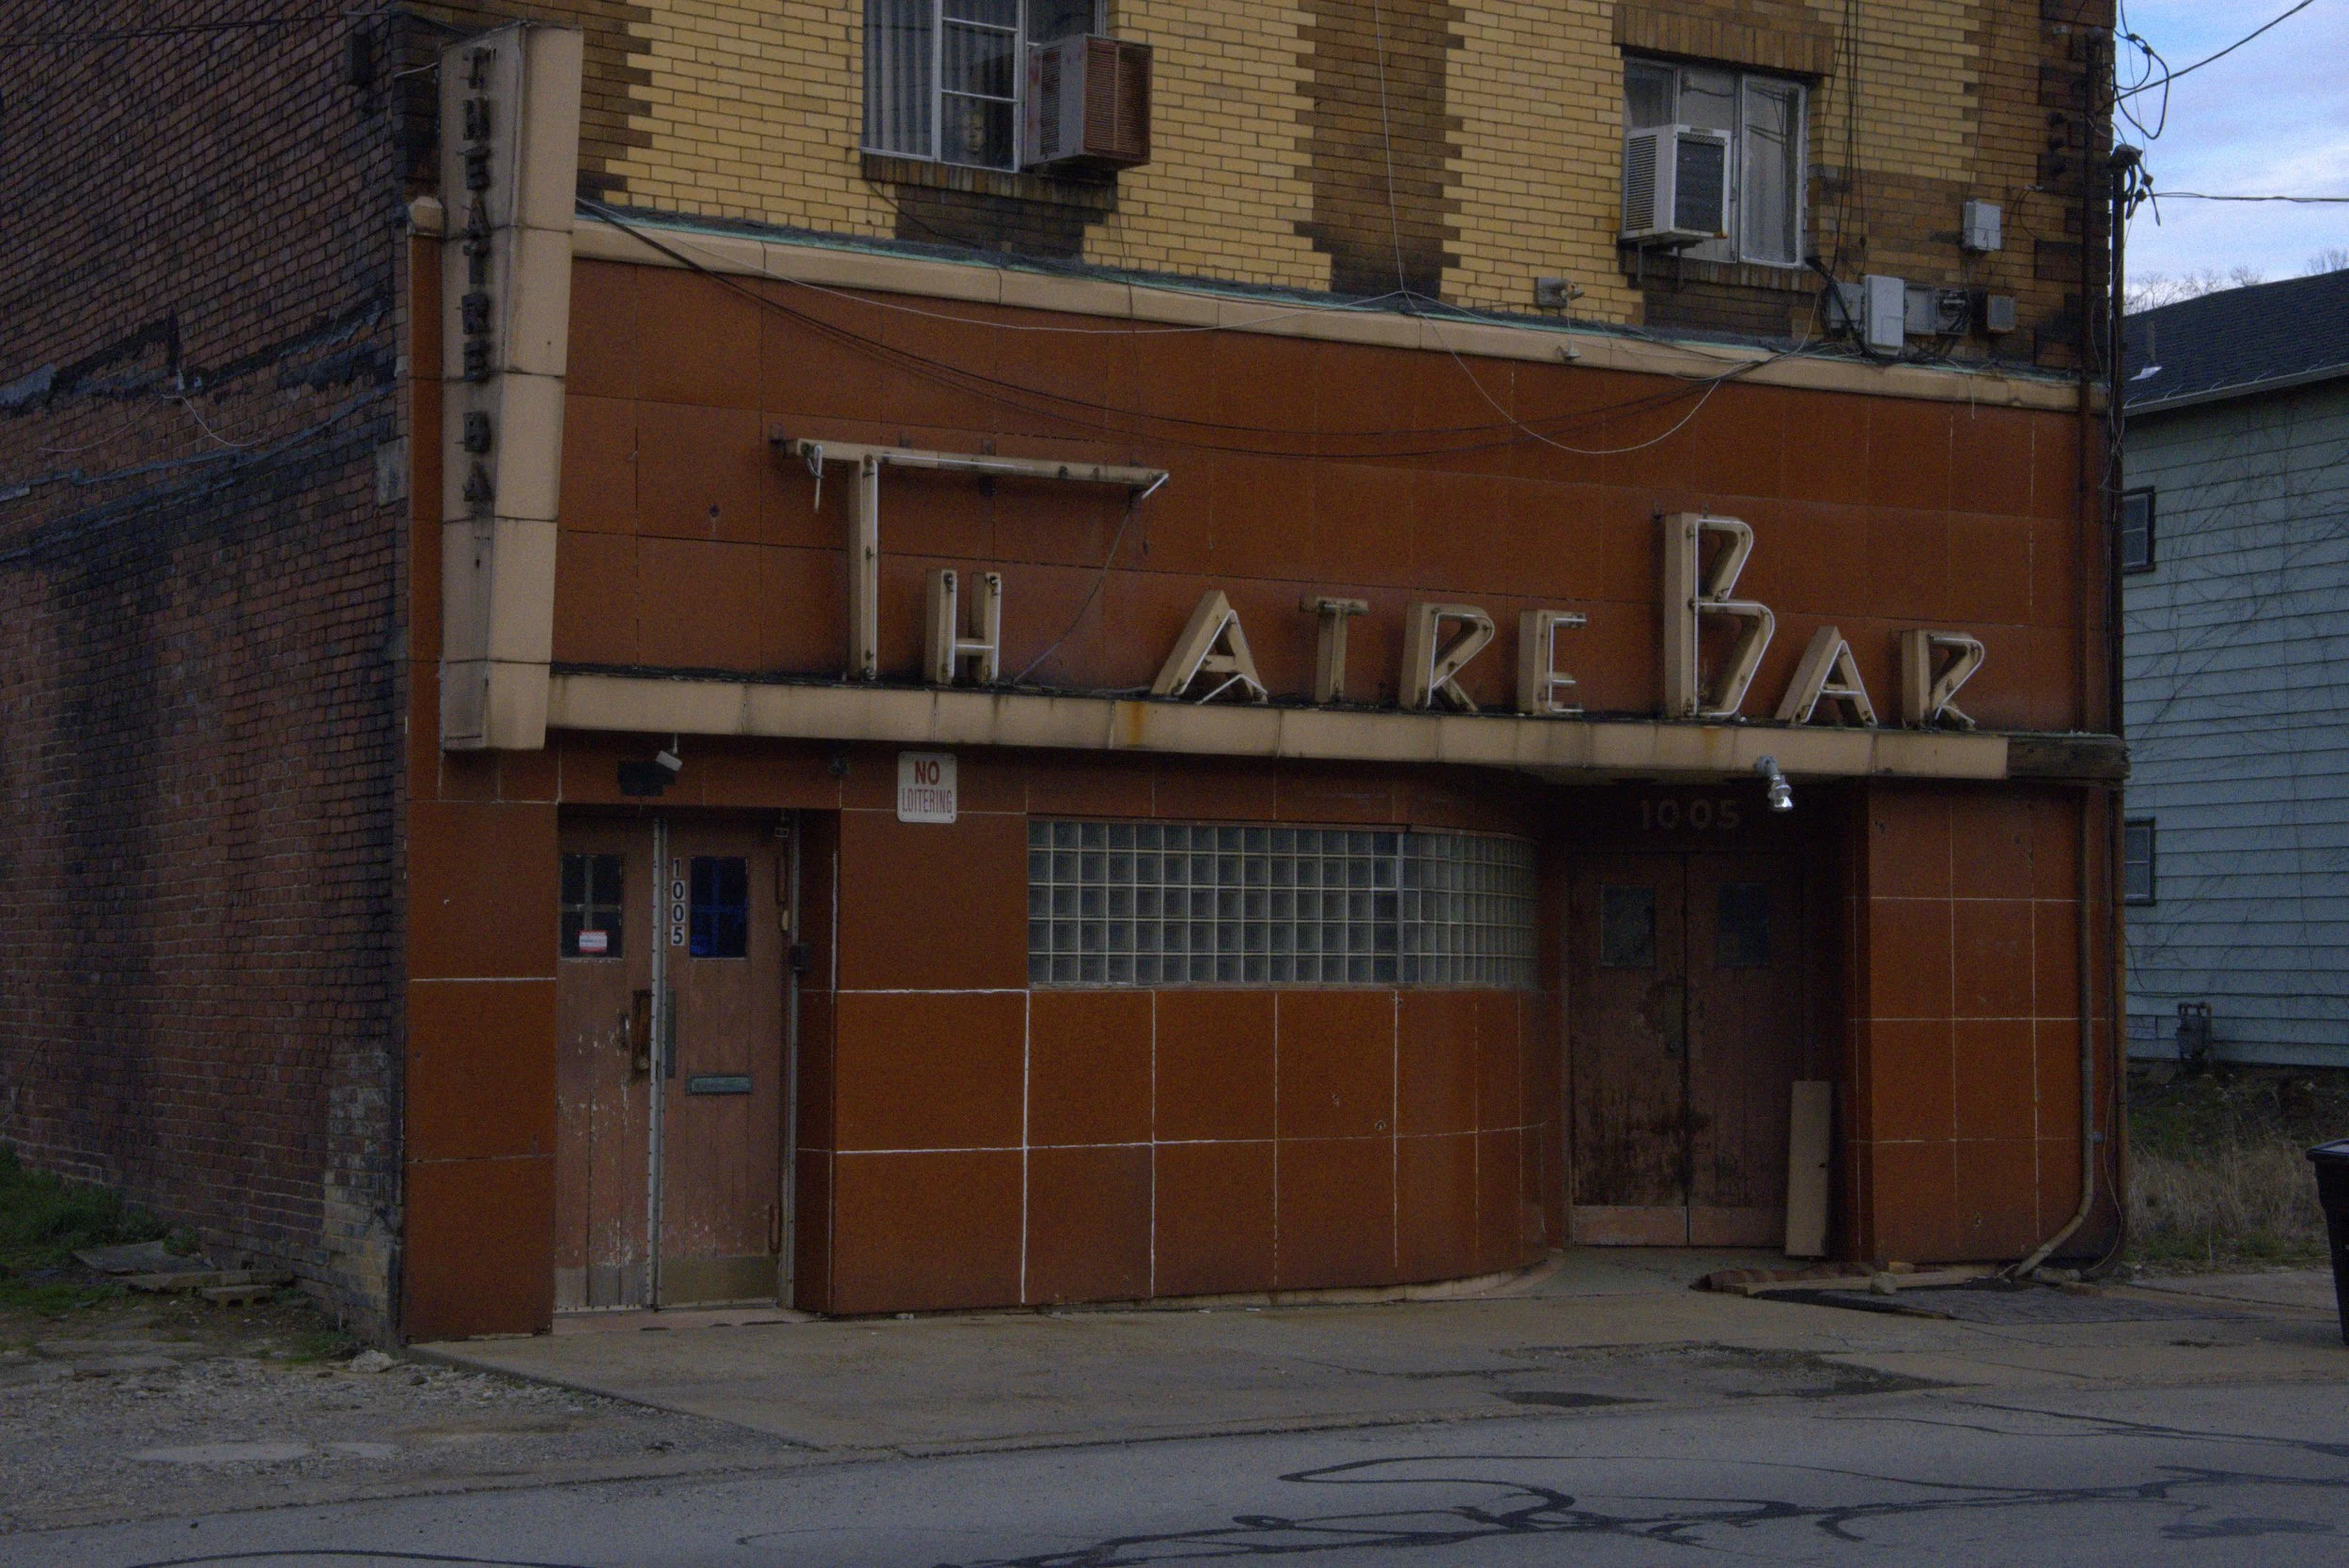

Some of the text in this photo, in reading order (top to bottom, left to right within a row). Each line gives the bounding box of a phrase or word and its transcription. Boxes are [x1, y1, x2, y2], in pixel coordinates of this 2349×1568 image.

[1663, 512, 1985, 731] BAR
[914, 760, 941, 785] NO
[902, 787, 953, 814] LOITERING
[1640, 799, 1739, 830] 1005
[672, 859, 685, 945] 1005
